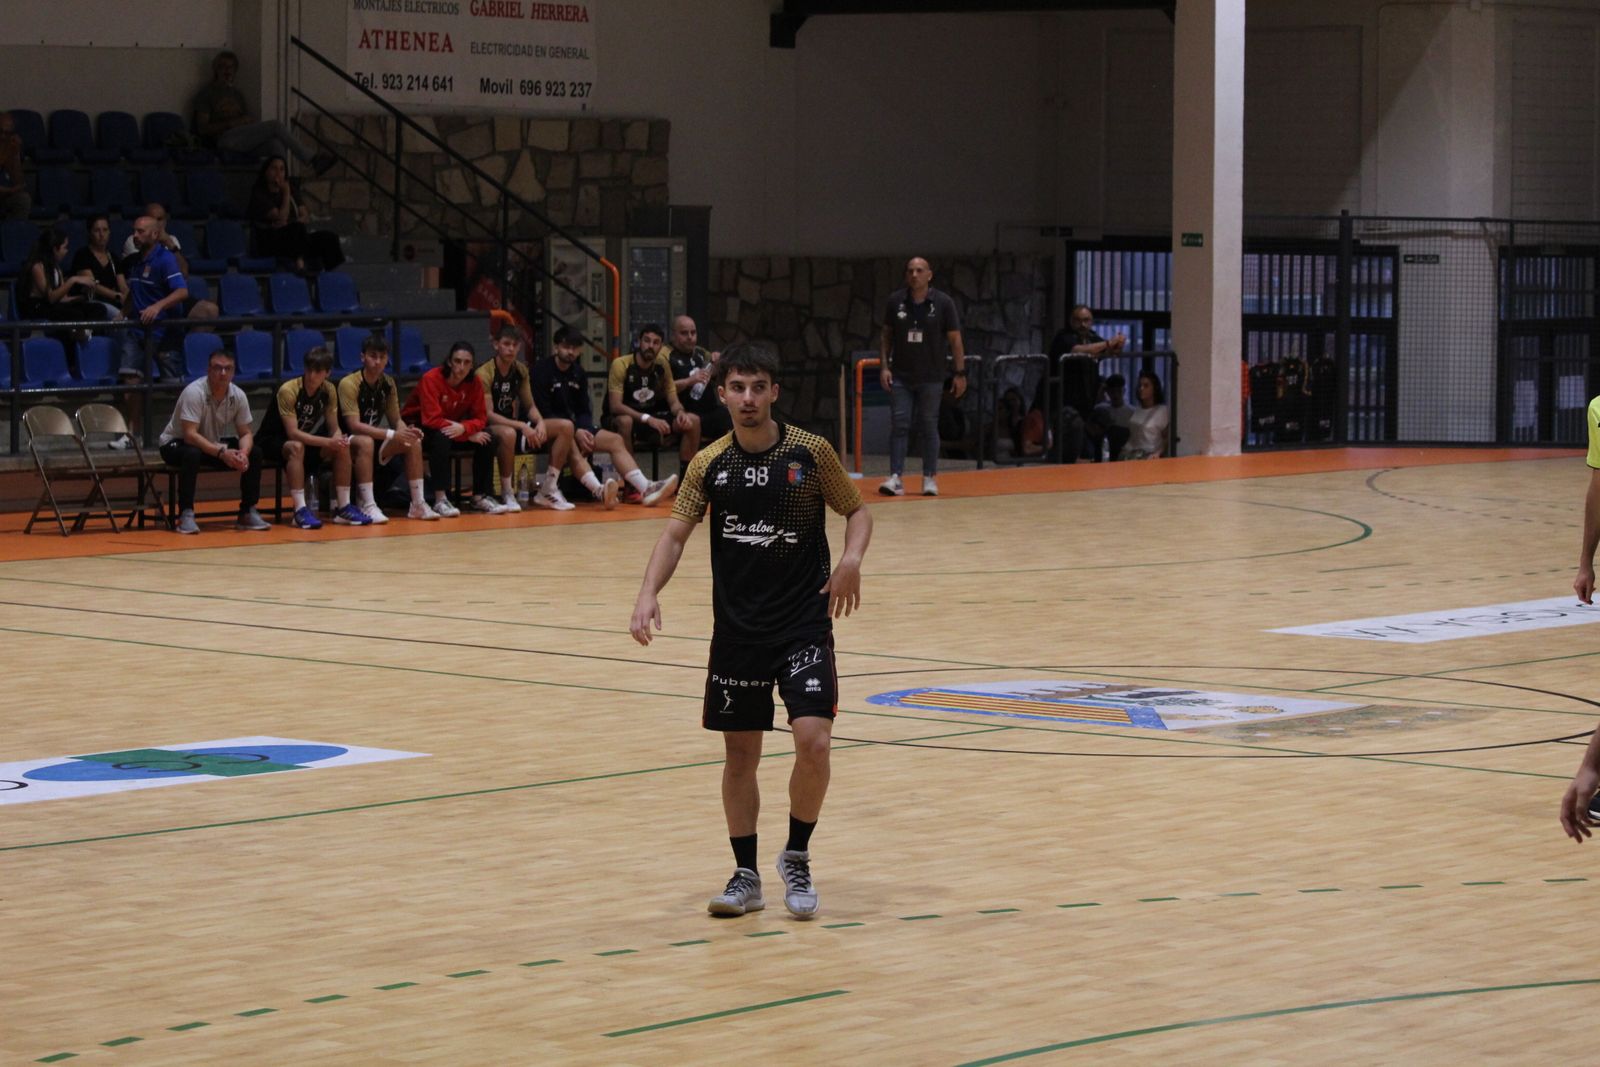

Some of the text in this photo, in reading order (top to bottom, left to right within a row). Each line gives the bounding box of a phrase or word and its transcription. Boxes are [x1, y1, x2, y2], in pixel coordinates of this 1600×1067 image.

[404, 1, 460, 15] ELECTRICOS
[470, 0, 589, 22] GABRIEL HERRERA
[358, 29, 454, 53] ATHENEA
[470, 42, 590, 60] ELECTRICIDAD EN GENERAL
[354, 72, 453, 92] Tel. 923 214 641
[480, 78, 592, 98] Movil 696 923 237
[744, 466, 769, 487] 98
[712, 674, 770, 687] Pubeer
